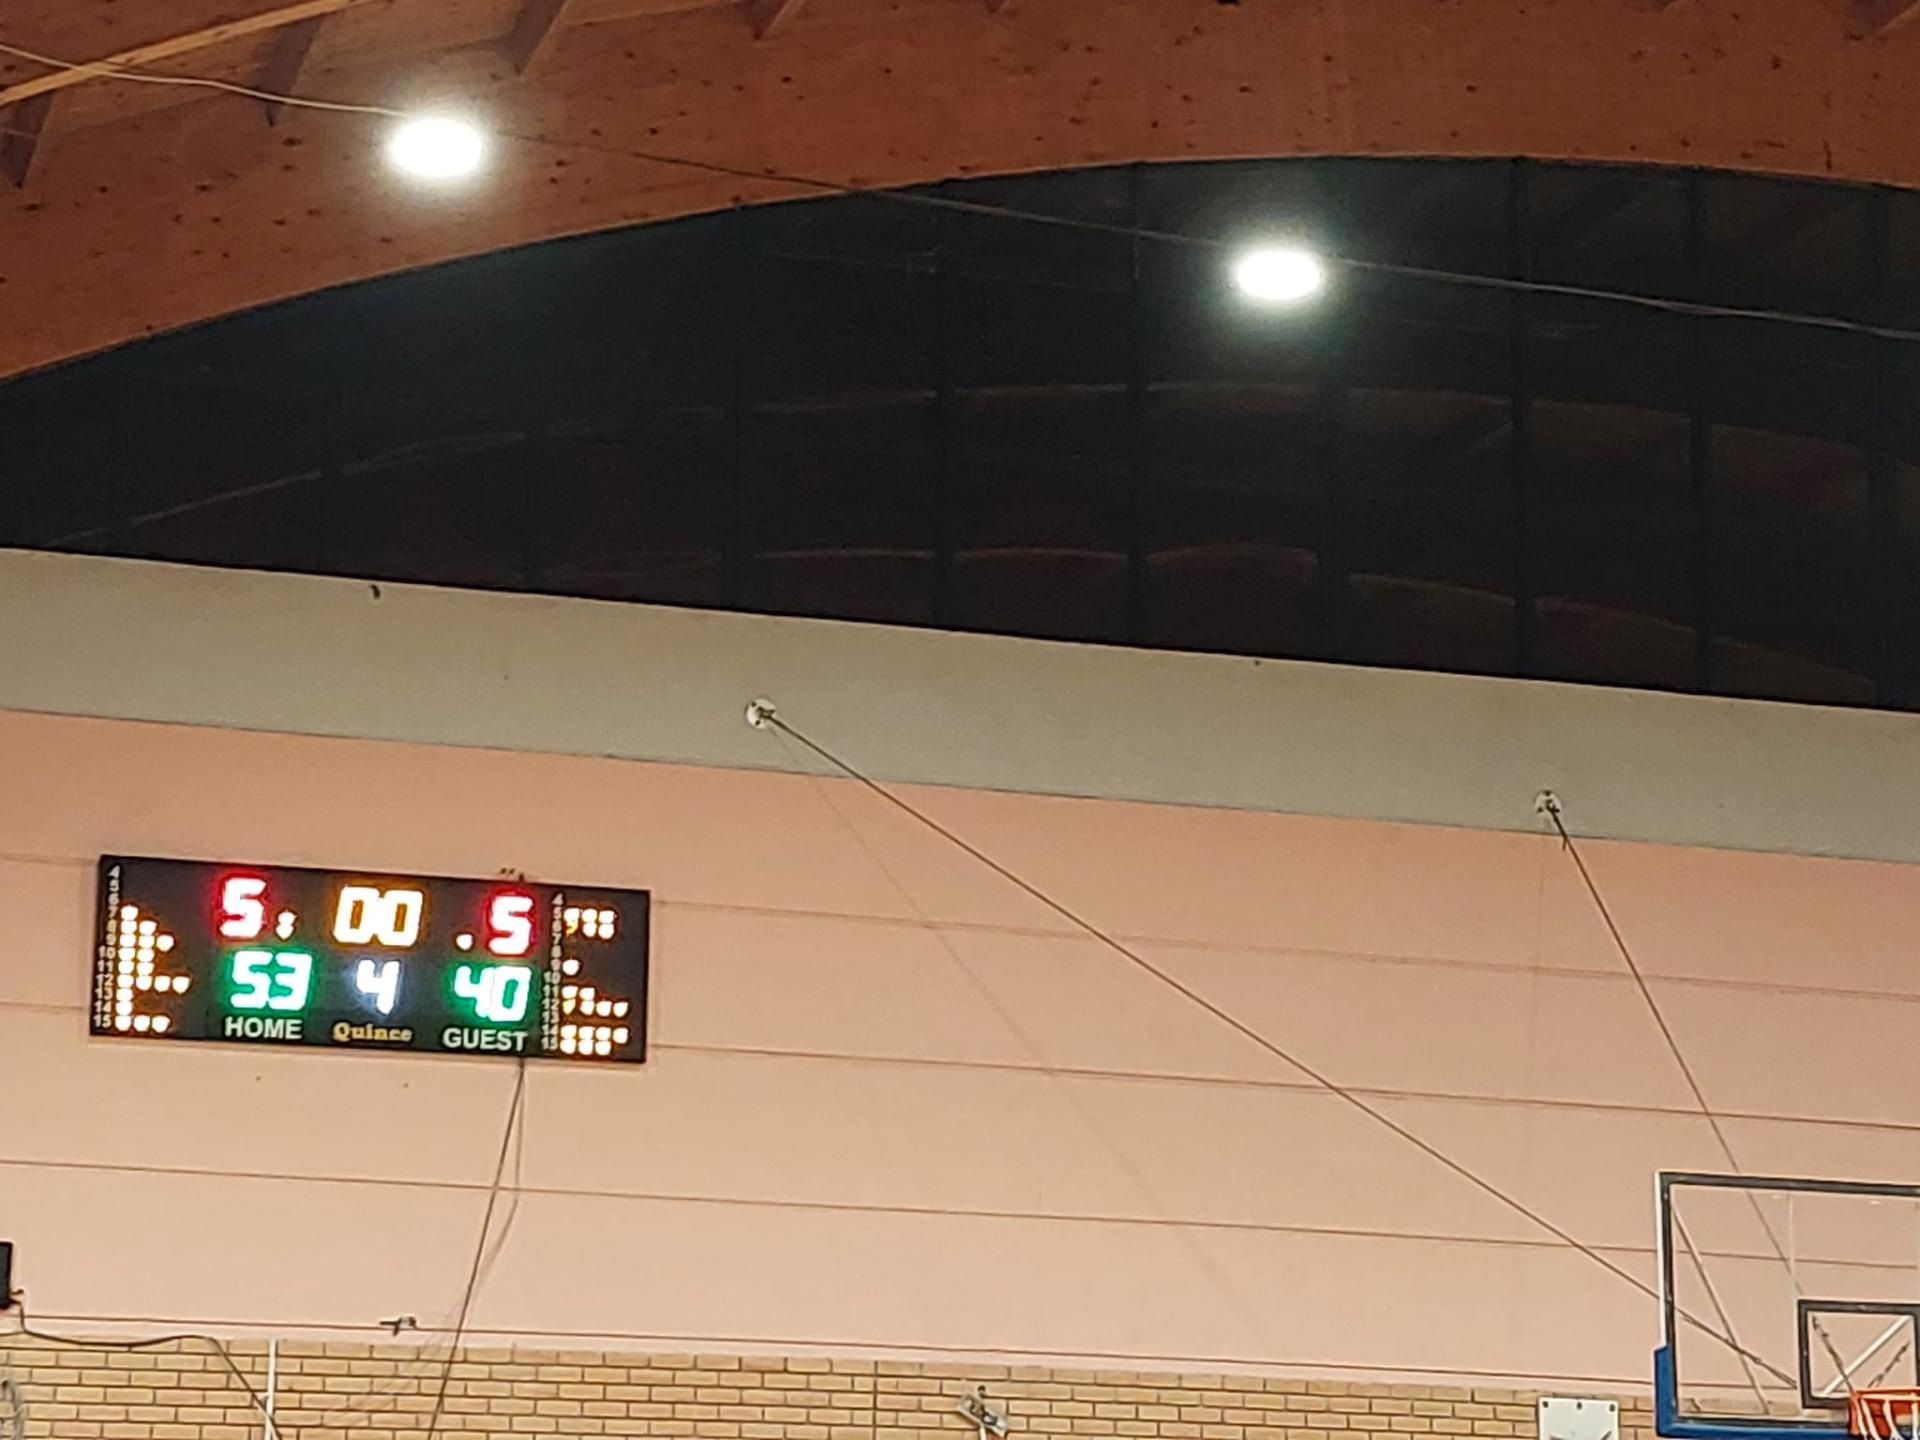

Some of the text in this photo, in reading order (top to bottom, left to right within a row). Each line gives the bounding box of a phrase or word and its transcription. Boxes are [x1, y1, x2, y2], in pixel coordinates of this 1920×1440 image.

[108, 865, 120, 877] 4
[109, 880, 119, 891] 5
[108, 893, 119, 904] 6
[108, 907, 118, 918] 7
[220, 877, 267, 938] 5
[106, 920, 117, 932] 8
[106, 934, 116, 945] 9
[99, 947, 115, 958] 10
[98, 961, 113, 972] 11
[97, 975, 113, 986] 12
[231, 951, 312, 1010] 53
[356, 960, 400, 1015] 4
[96, 988, 113, 1000] 13
[454, 965, 531, 1023] 40
[95, 1002, 112, 1013] 14
[94, 1015, 112, 1027] 15
[225, 1018, 302, 1040] HOME
[334, 1023, 412, 1043] Quince
[444, 1029, 528, 1051] GUEST
